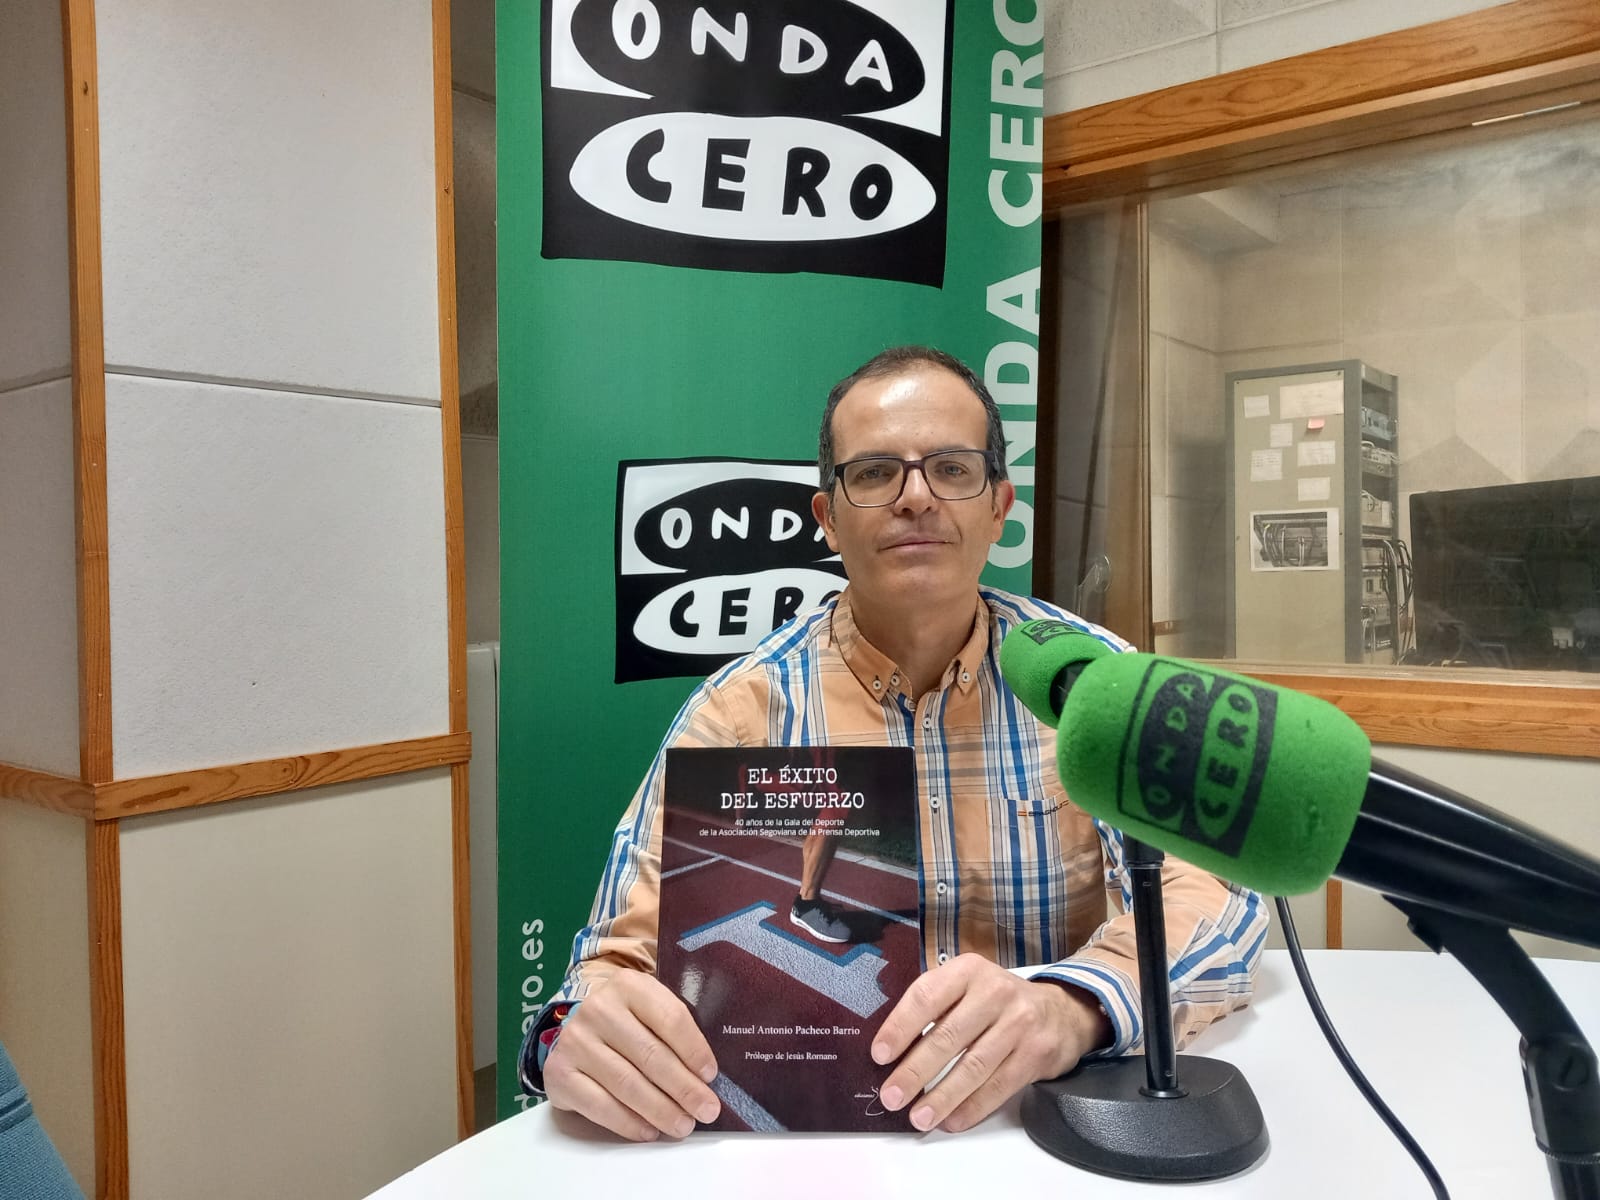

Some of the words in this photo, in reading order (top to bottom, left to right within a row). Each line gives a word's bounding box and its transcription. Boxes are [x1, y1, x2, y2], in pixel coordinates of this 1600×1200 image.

[611, 0, 894, 92] ONDA
[988, 0, 1045, 228] CERO
[626, 128, 893, 221] CERO
[660, 506, 825, 550] OND
[669, 586, 842, 638] CER
[1147, 682, 1196, 806] ONDA
[1201, 692, 1254, 819] CERO
[747, 768, 773, 784] EL
[778, 764, 838, 784] ÉXITO
[720, 792, 759, 809] DEL
[764, 792, 865, 809] ESFUERZO
[699, 829, 709, 837] de
[710, 828, 718, 837] la
[718, 827, 758, 837] Asociación
[759, 828, 797, 838] Segoviana
[798, 828, 808, 836] de
[809, 828, 816, 836] la
[818, 828, 843, 836] Prensa
[844, 828, 881, 838] Deportiva
[735, 818, 744, 826] 40
[745, 818, 763, 827] años
[764, 818, 774, 826] de
[775, 818, 783, 826] la
[784, 818, 800, 826] Gala
[801, 818, 814, 826] del
[815, 818, 845, 828] Deporte
[722, 1024, 755, 1035] Manuel
[757, 1025, 793, 1035] Antonio
[795, 1025, 831, 1035] Pacheco
[832, 1025, 861, 1035] Barrio
[745, 1051, 774, 1061] Prólogo
[775, 1052, 785, 1060] de
[786, 1051, 805, 1061] Jesús
[806, 1052, 838, 1060] Romano
